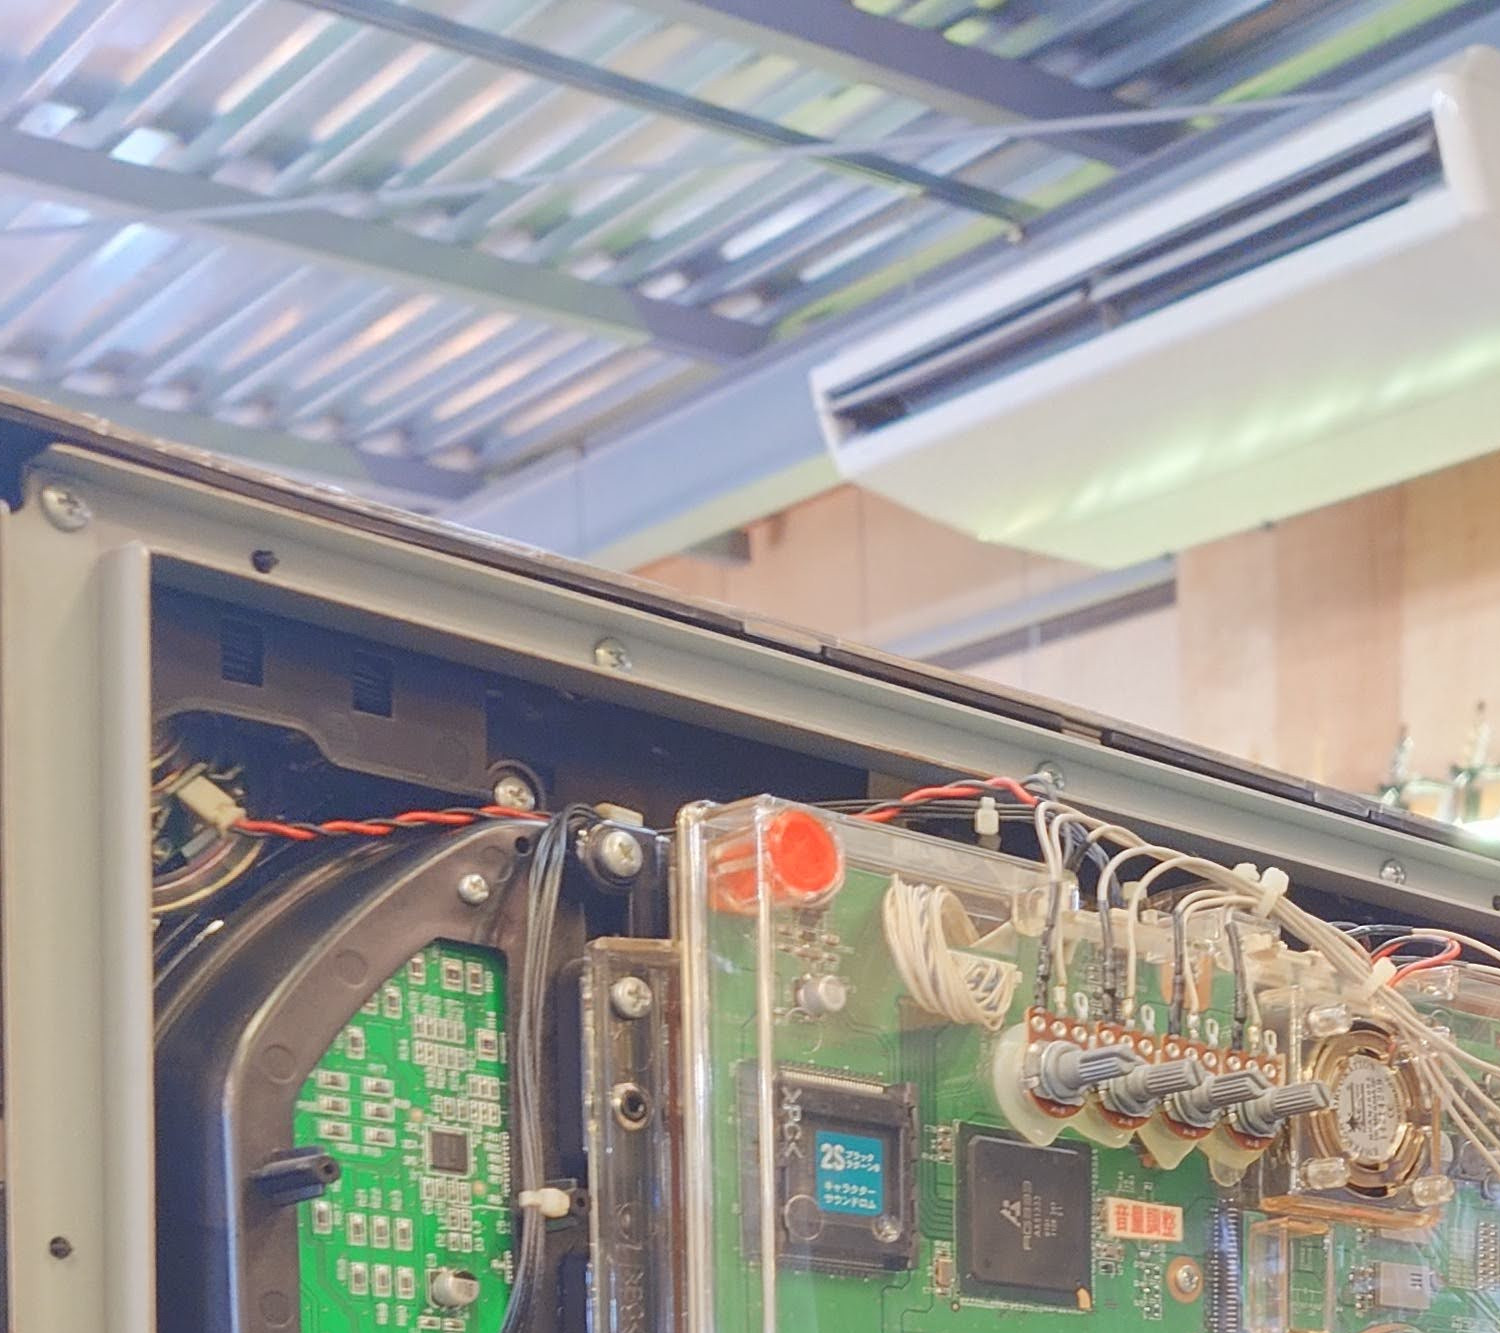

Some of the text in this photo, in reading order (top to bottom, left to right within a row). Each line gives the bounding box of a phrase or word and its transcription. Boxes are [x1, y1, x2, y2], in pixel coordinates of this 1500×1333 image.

[820, 1143, 845, 1171] 2S
[1114, 1203, 1177, 1238] 音量調整
